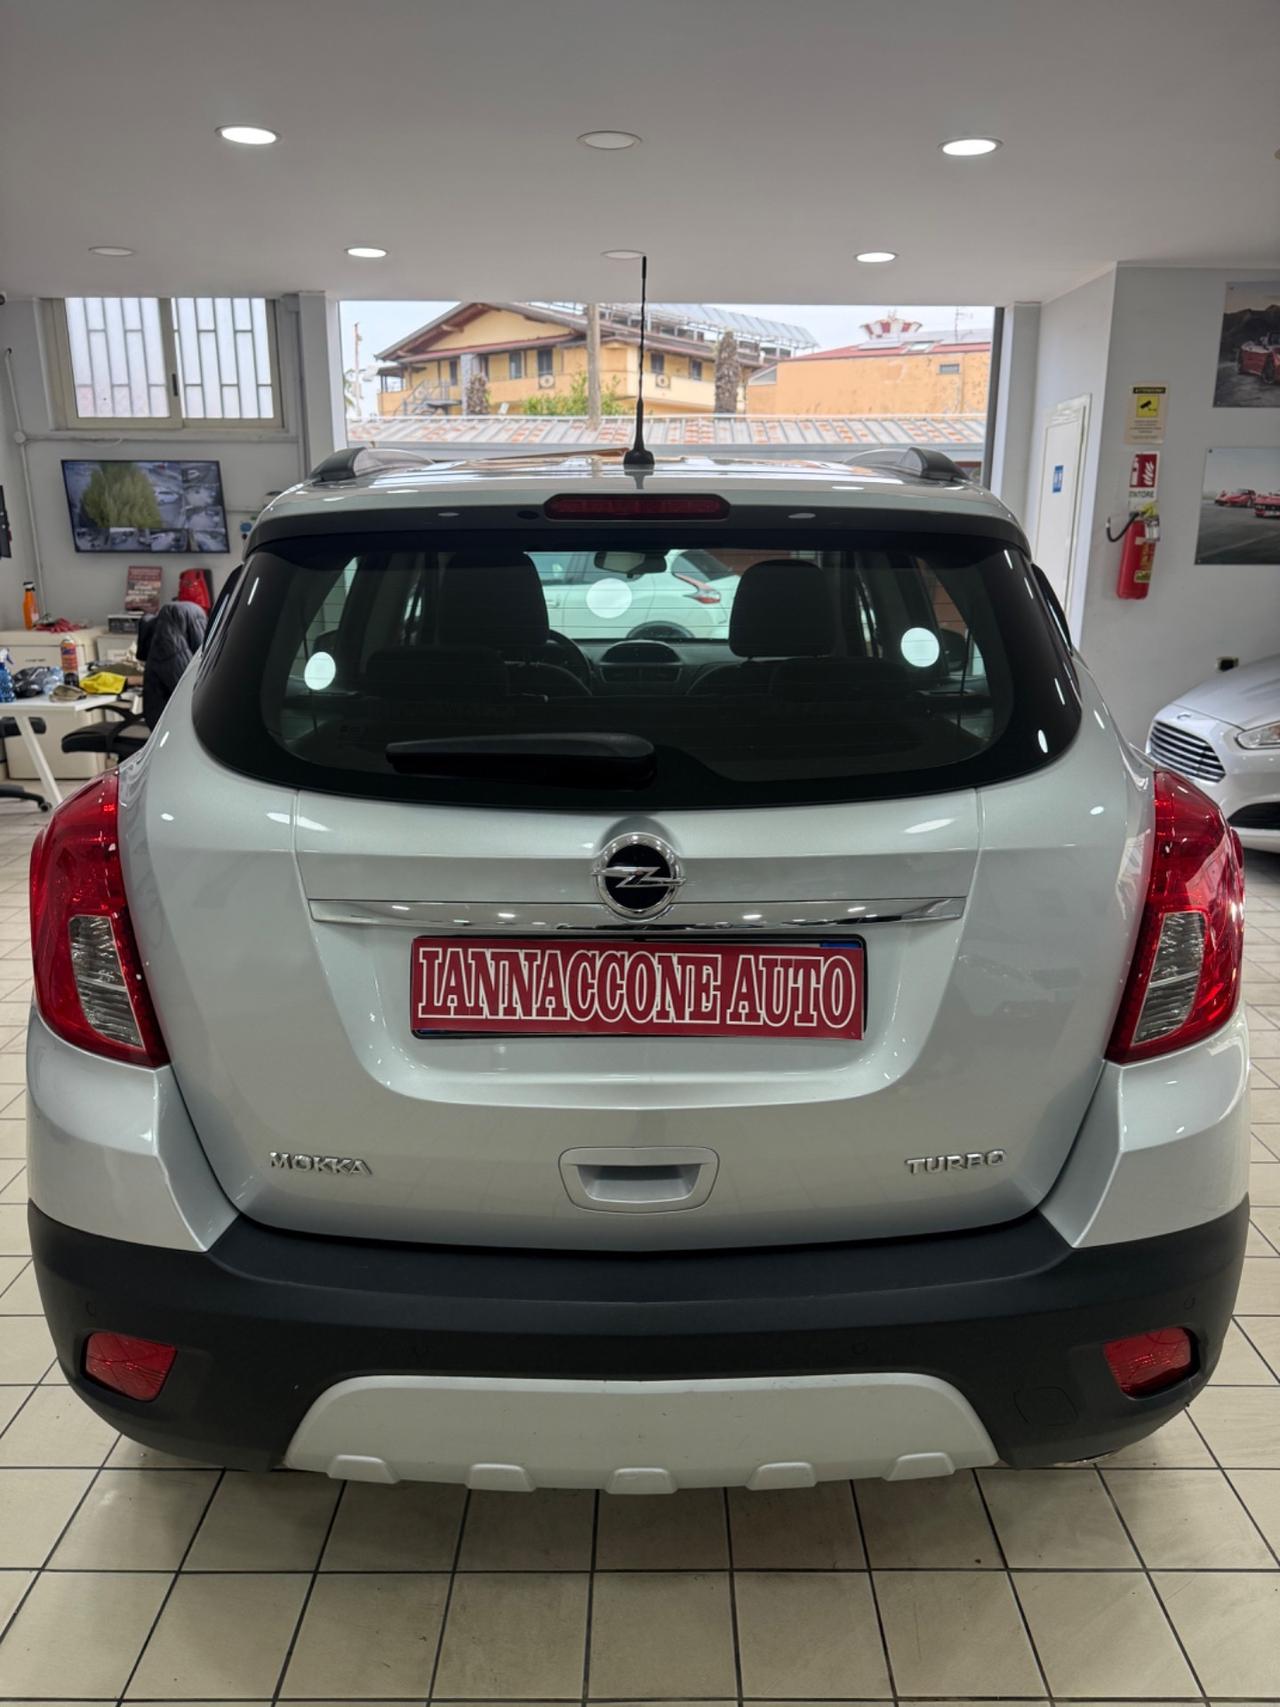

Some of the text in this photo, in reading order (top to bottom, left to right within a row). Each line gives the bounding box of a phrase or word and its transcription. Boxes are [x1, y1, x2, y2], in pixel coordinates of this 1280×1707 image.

[418, 947, 857, 1029] IANNACCONE AUTO
[269, 1151, 372, 1176] MOKKA
[904, 1148, 1007, 1175] TURBO
